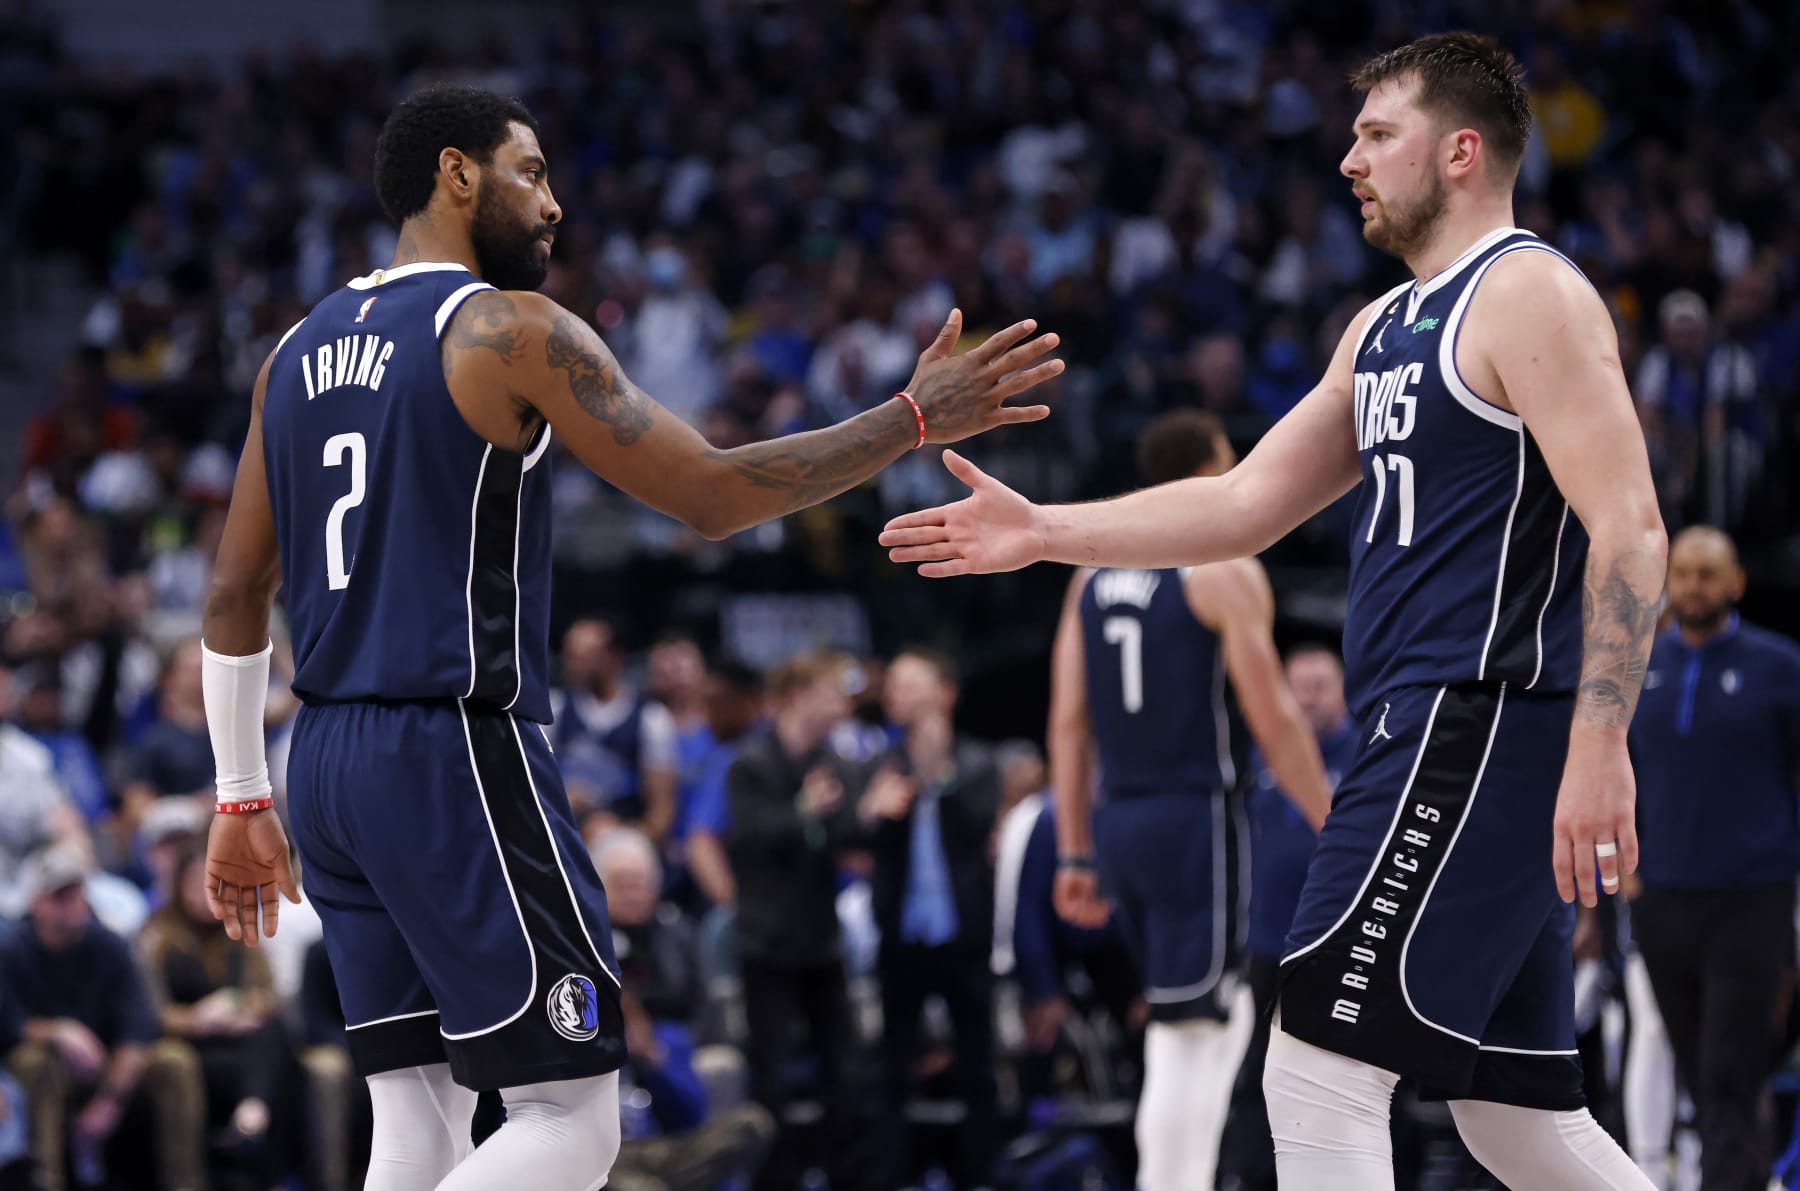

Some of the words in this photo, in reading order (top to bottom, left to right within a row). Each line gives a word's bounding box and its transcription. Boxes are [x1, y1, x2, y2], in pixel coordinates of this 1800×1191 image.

[302, 334, 394, 400] IRVING
[1354, 362, 1424, 451] MAVS
[323, 432, 366, 591] 2
[1103, 615, 1143, 715] 7
[1331, 803, 1441, 1024] MAVERICKS
